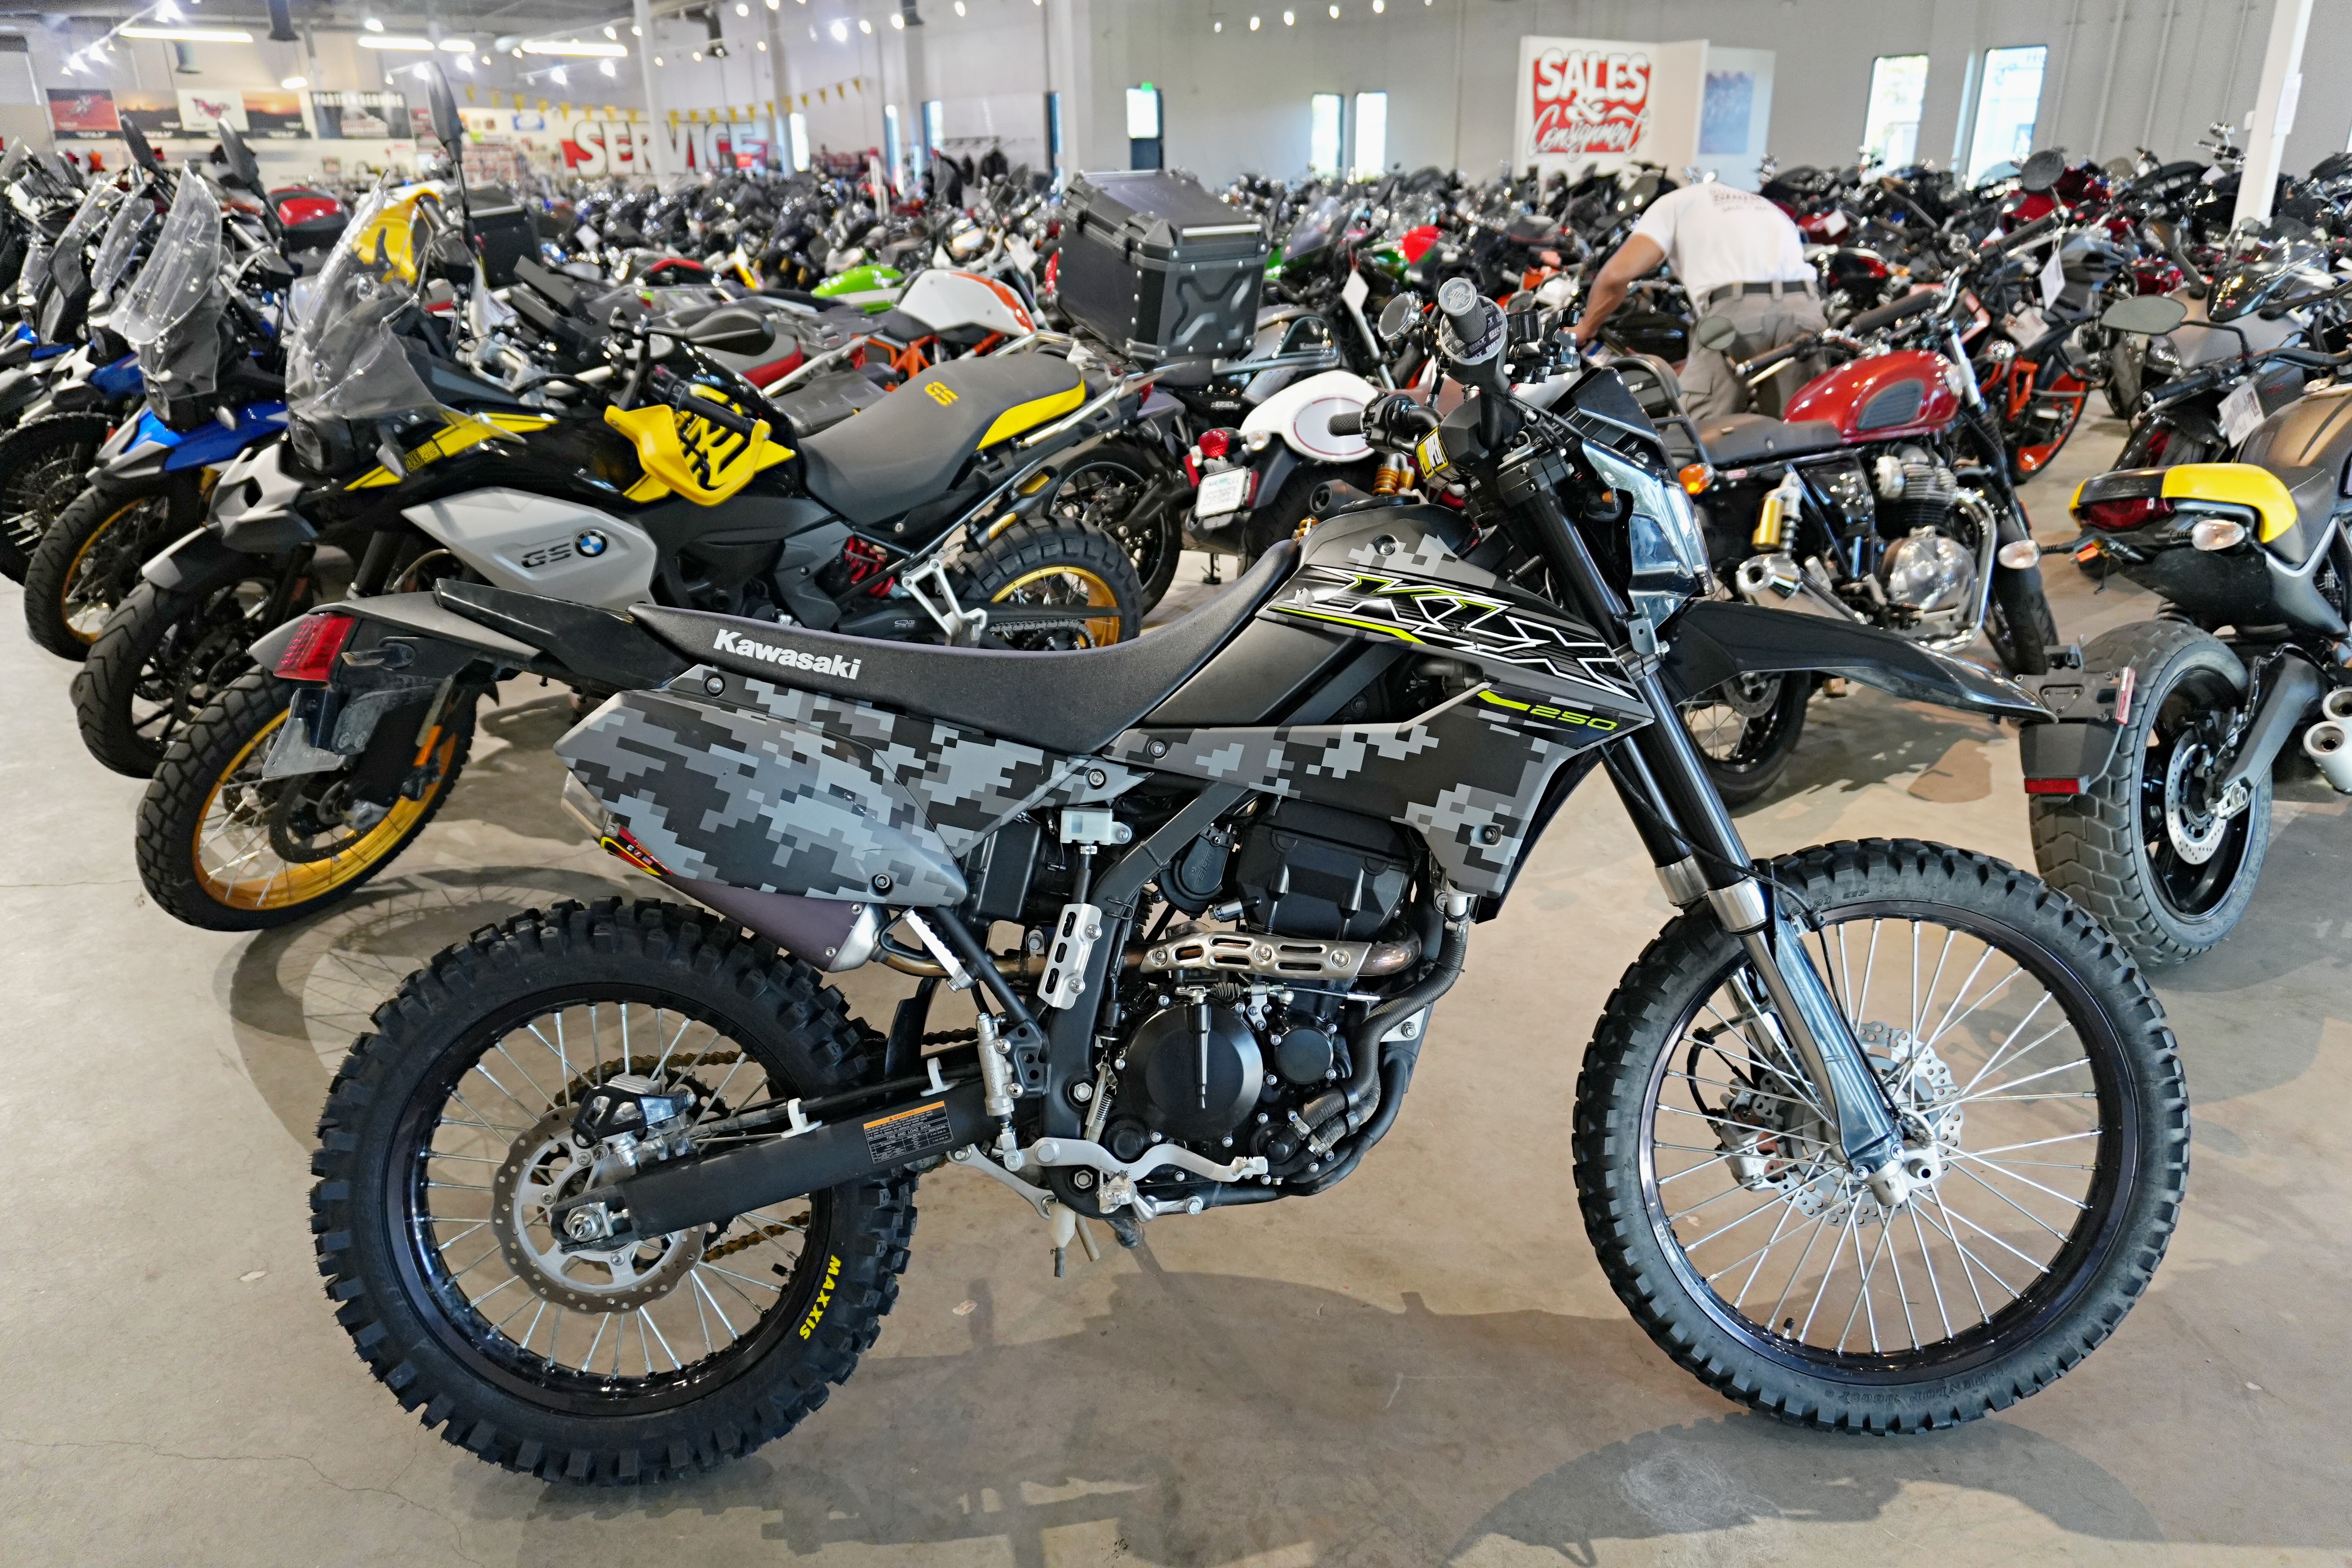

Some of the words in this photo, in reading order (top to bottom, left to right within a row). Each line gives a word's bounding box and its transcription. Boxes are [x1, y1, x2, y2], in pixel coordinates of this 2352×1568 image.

[1537, 47, 1647, 104] SALES
[1565, 96, 1608, 123] &
[1528, 104, 1650, 163] Consignment
[1468, 336, 1486, 351] BILT
[522, 541, 572, 569] GS
[713, 628, 861, 680] Kawasaki
[1529, 705, 1618, 731] 250
[893, 1110, 916, 1120] WARNING
[799, 1254, 842, 1340] MAXXIS
